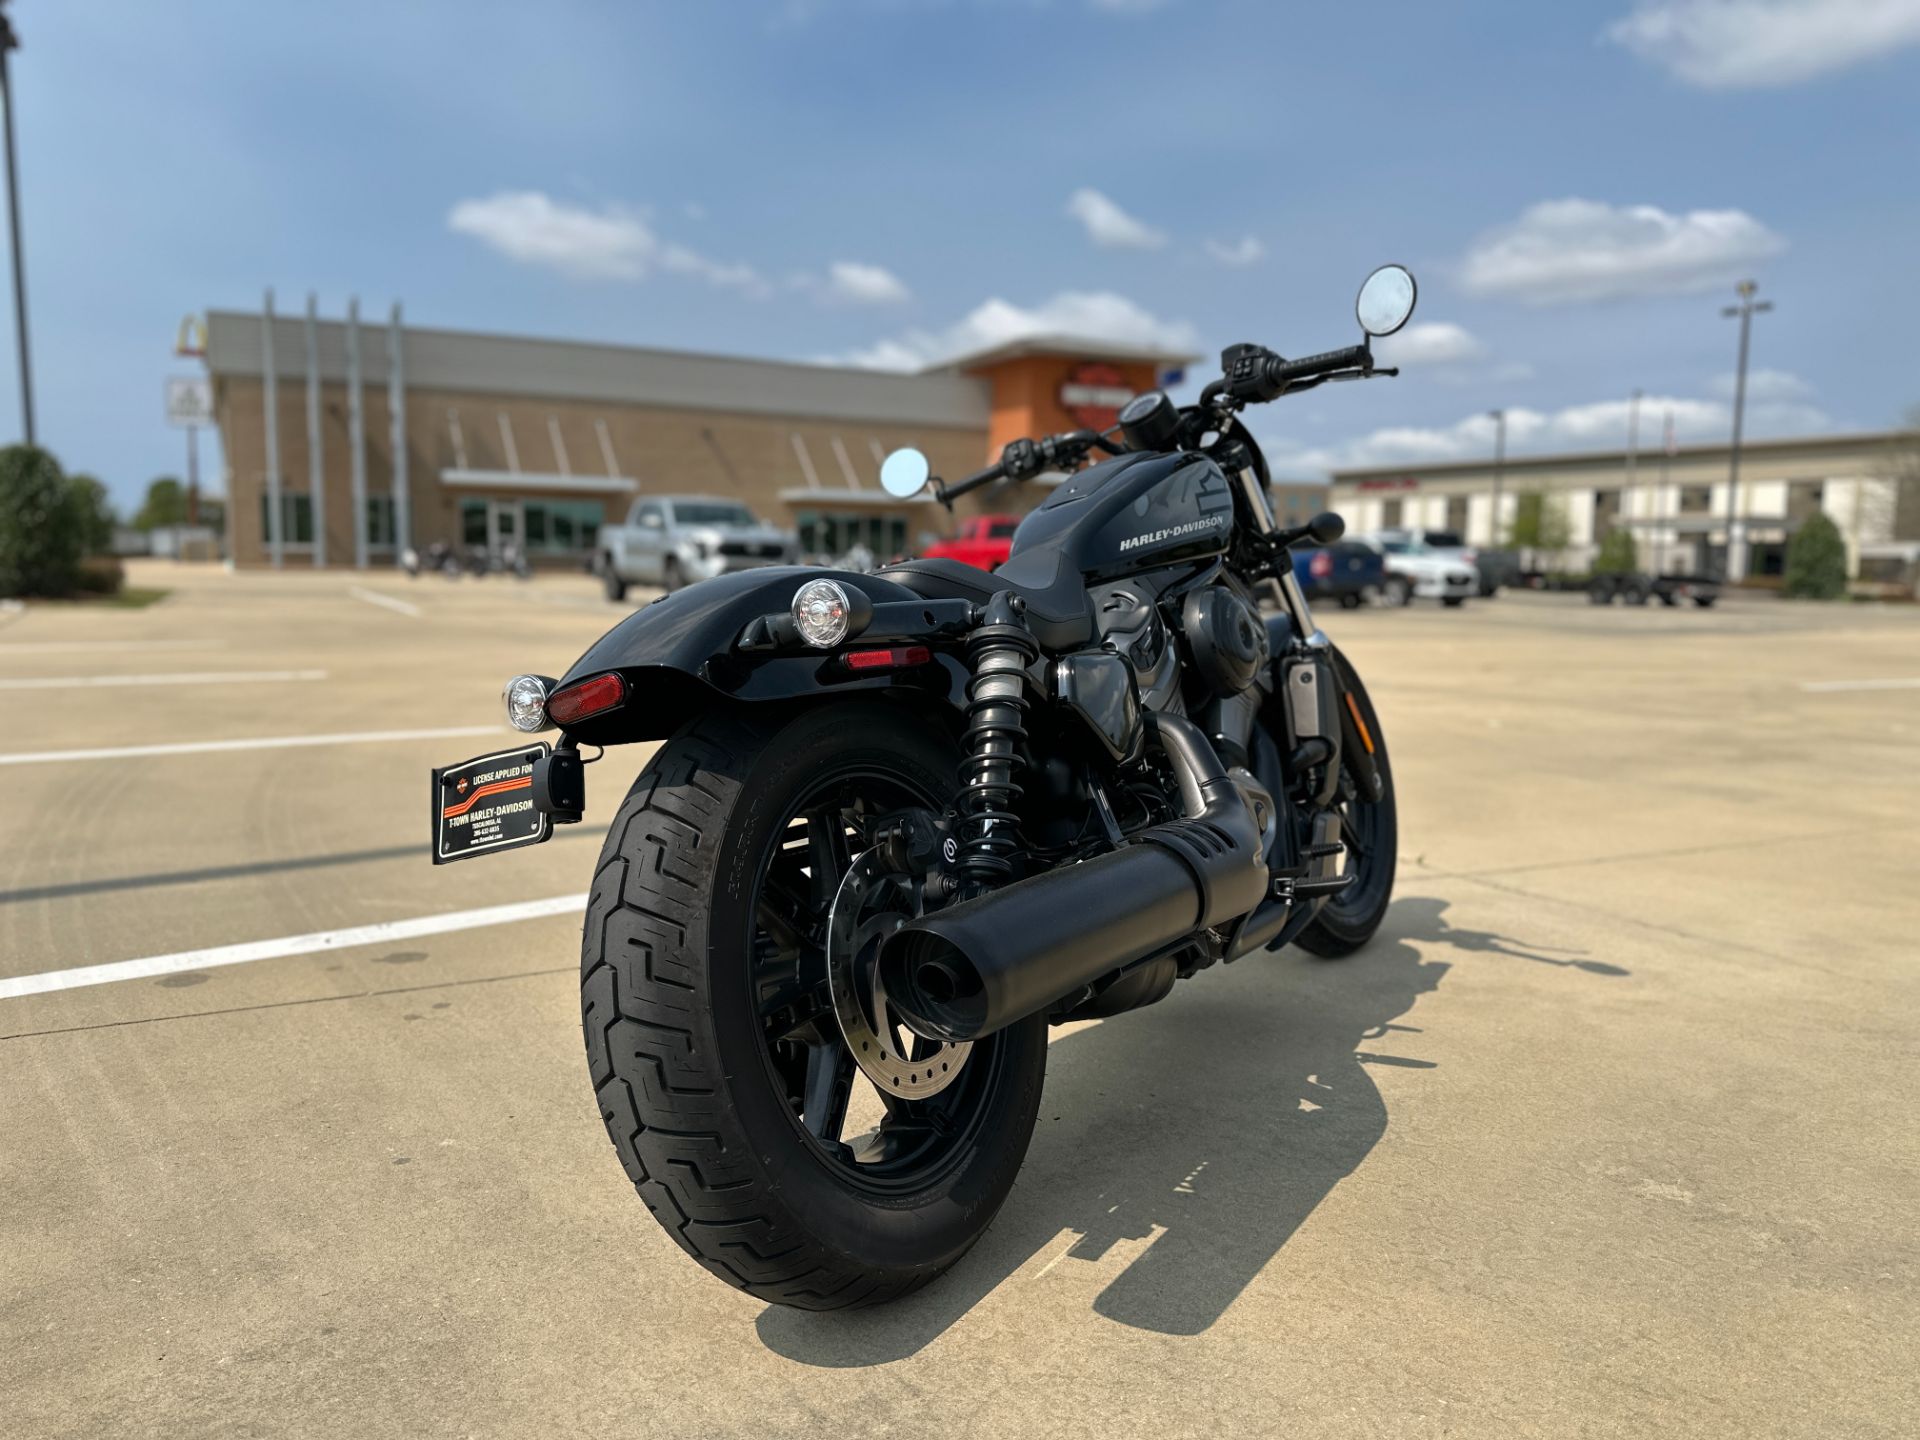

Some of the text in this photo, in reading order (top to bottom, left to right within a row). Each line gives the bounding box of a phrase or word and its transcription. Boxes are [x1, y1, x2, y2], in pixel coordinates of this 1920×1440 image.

[1120, 515, 1223, 551] HARLEY-DAVIDSON
[473, 763, 533, 785] LICENSE APPLIED FOR
[449, 799, 533, 828] T-TOWN HARLEY-DAVIDSON
